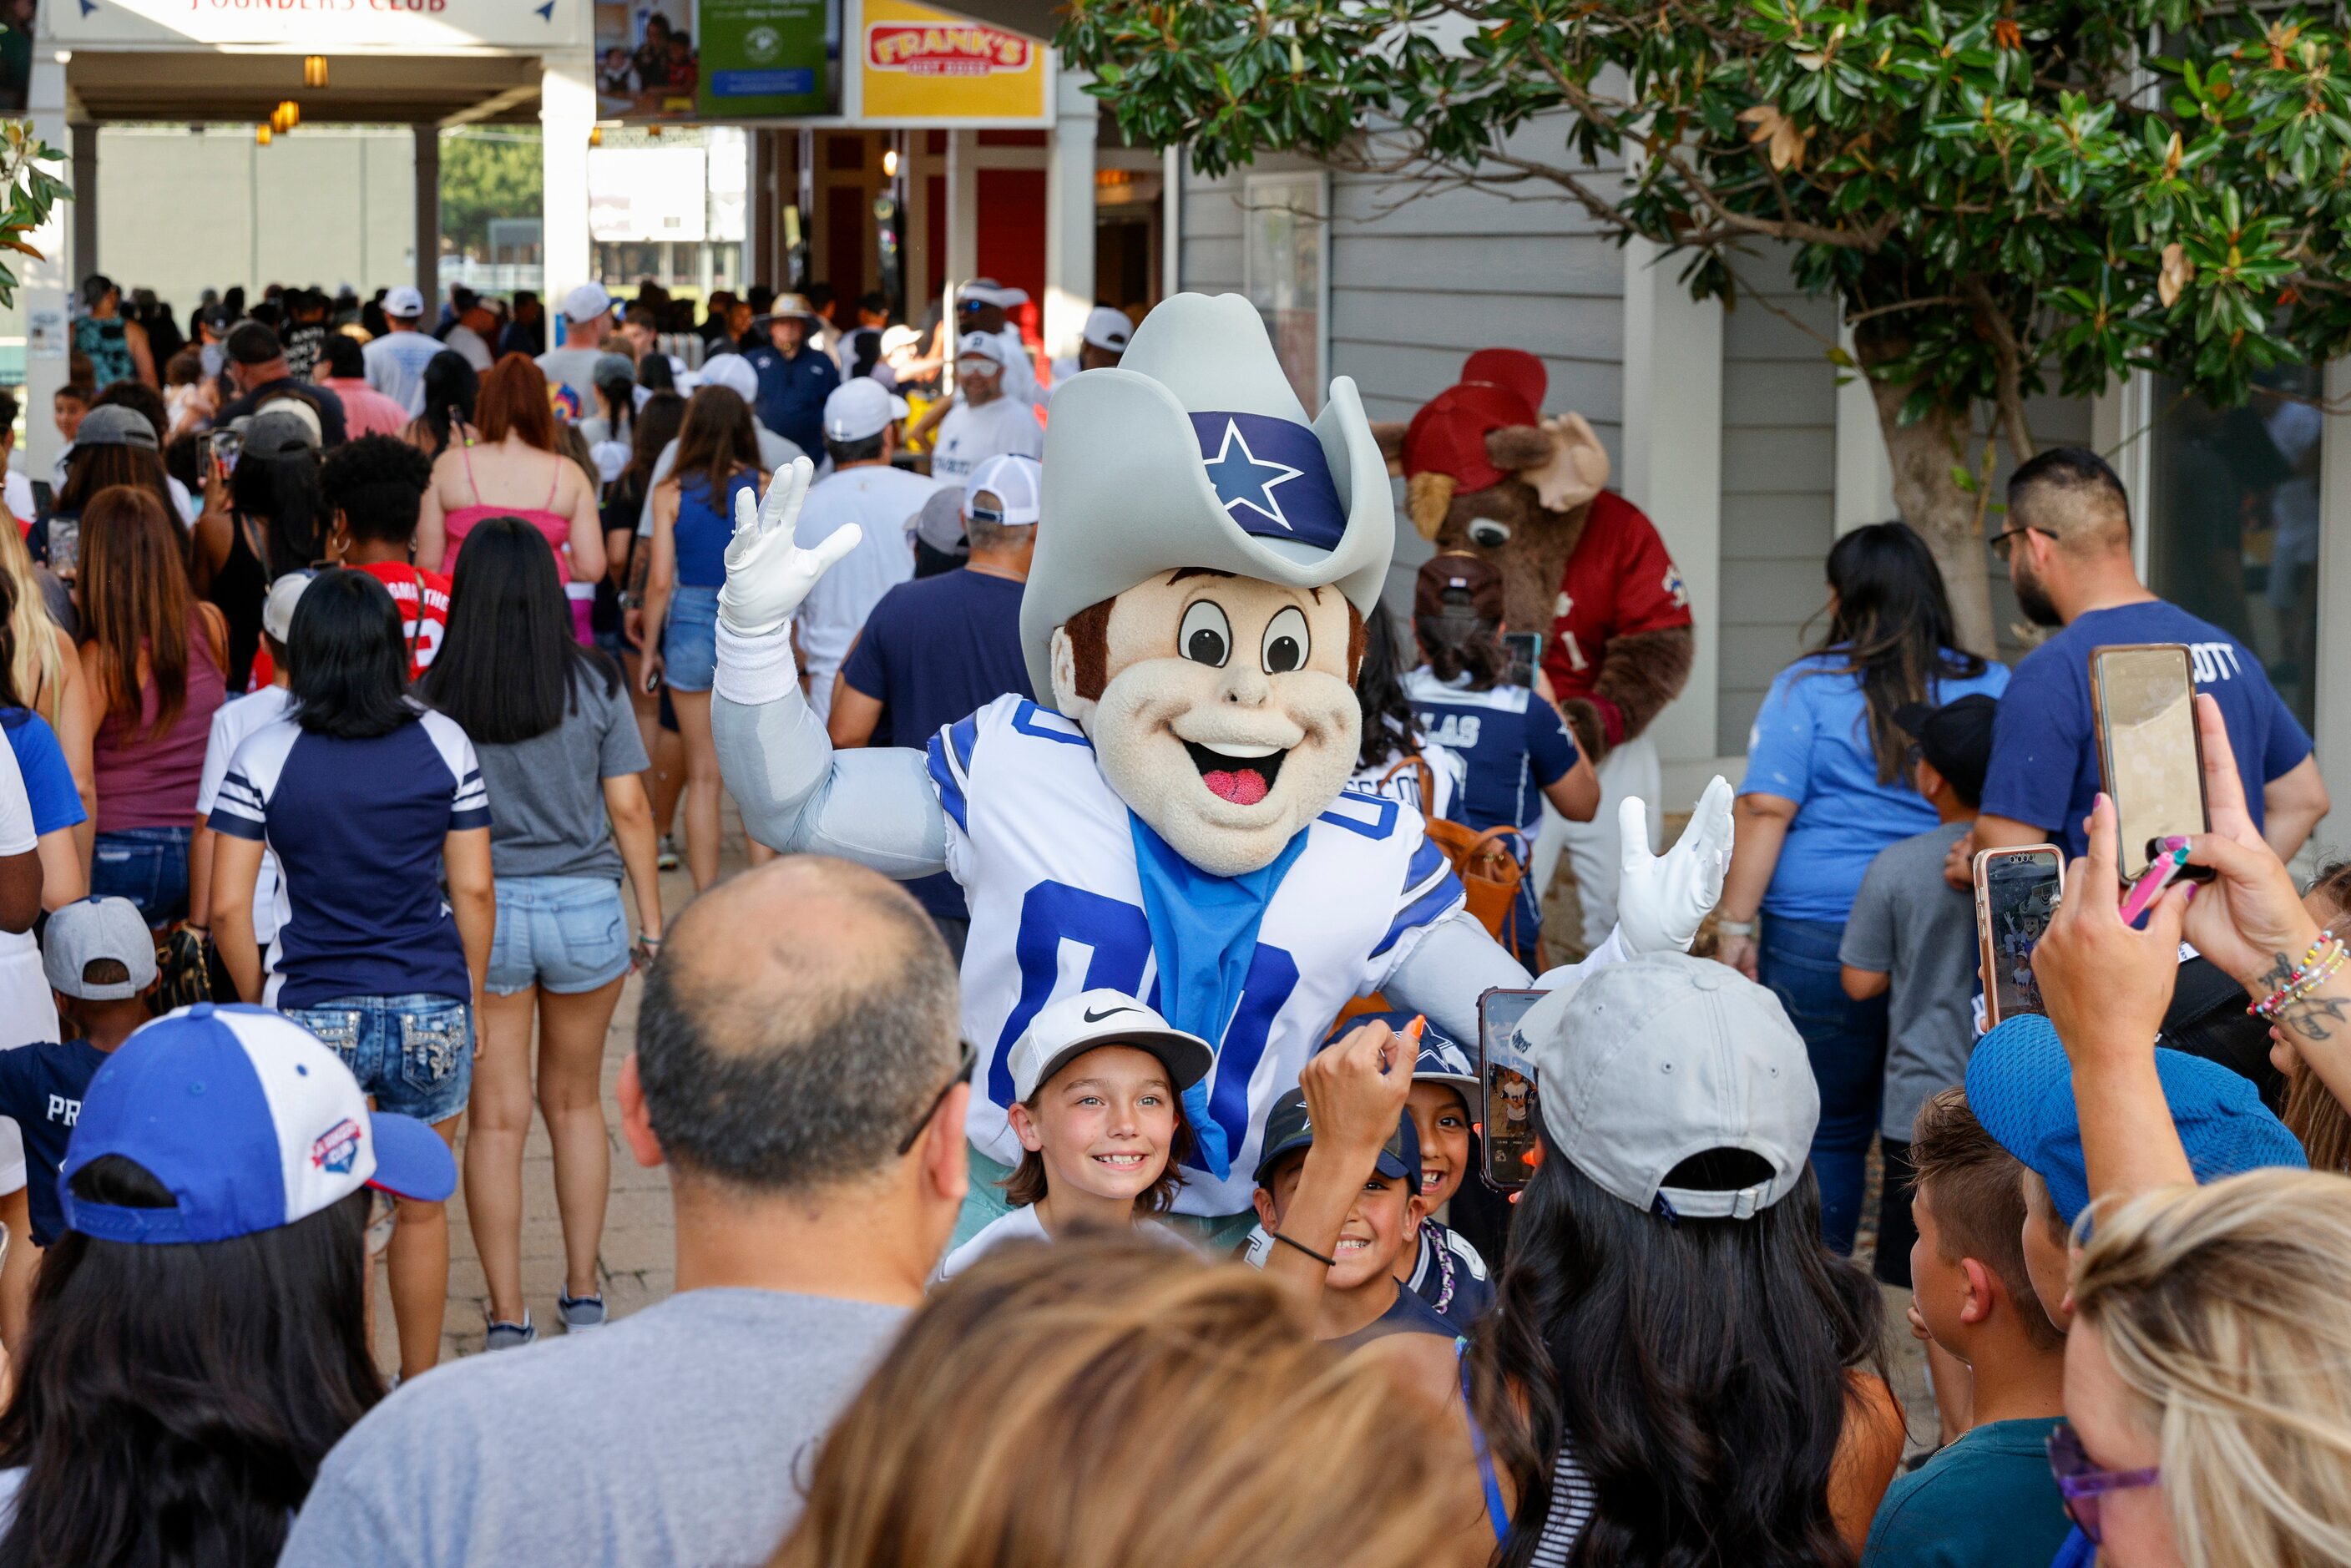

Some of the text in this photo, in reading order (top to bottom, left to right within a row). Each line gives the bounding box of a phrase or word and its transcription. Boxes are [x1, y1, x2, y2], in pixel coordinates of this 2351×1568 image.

[873, 28, 1024, 64] FRANK'S
[387, 581, 419, 601] GMA
[1560, 630, 1589, 672] 1
[1415, 712, 1482, 748] LAS
[47, 1093, 83, 1126] PR
